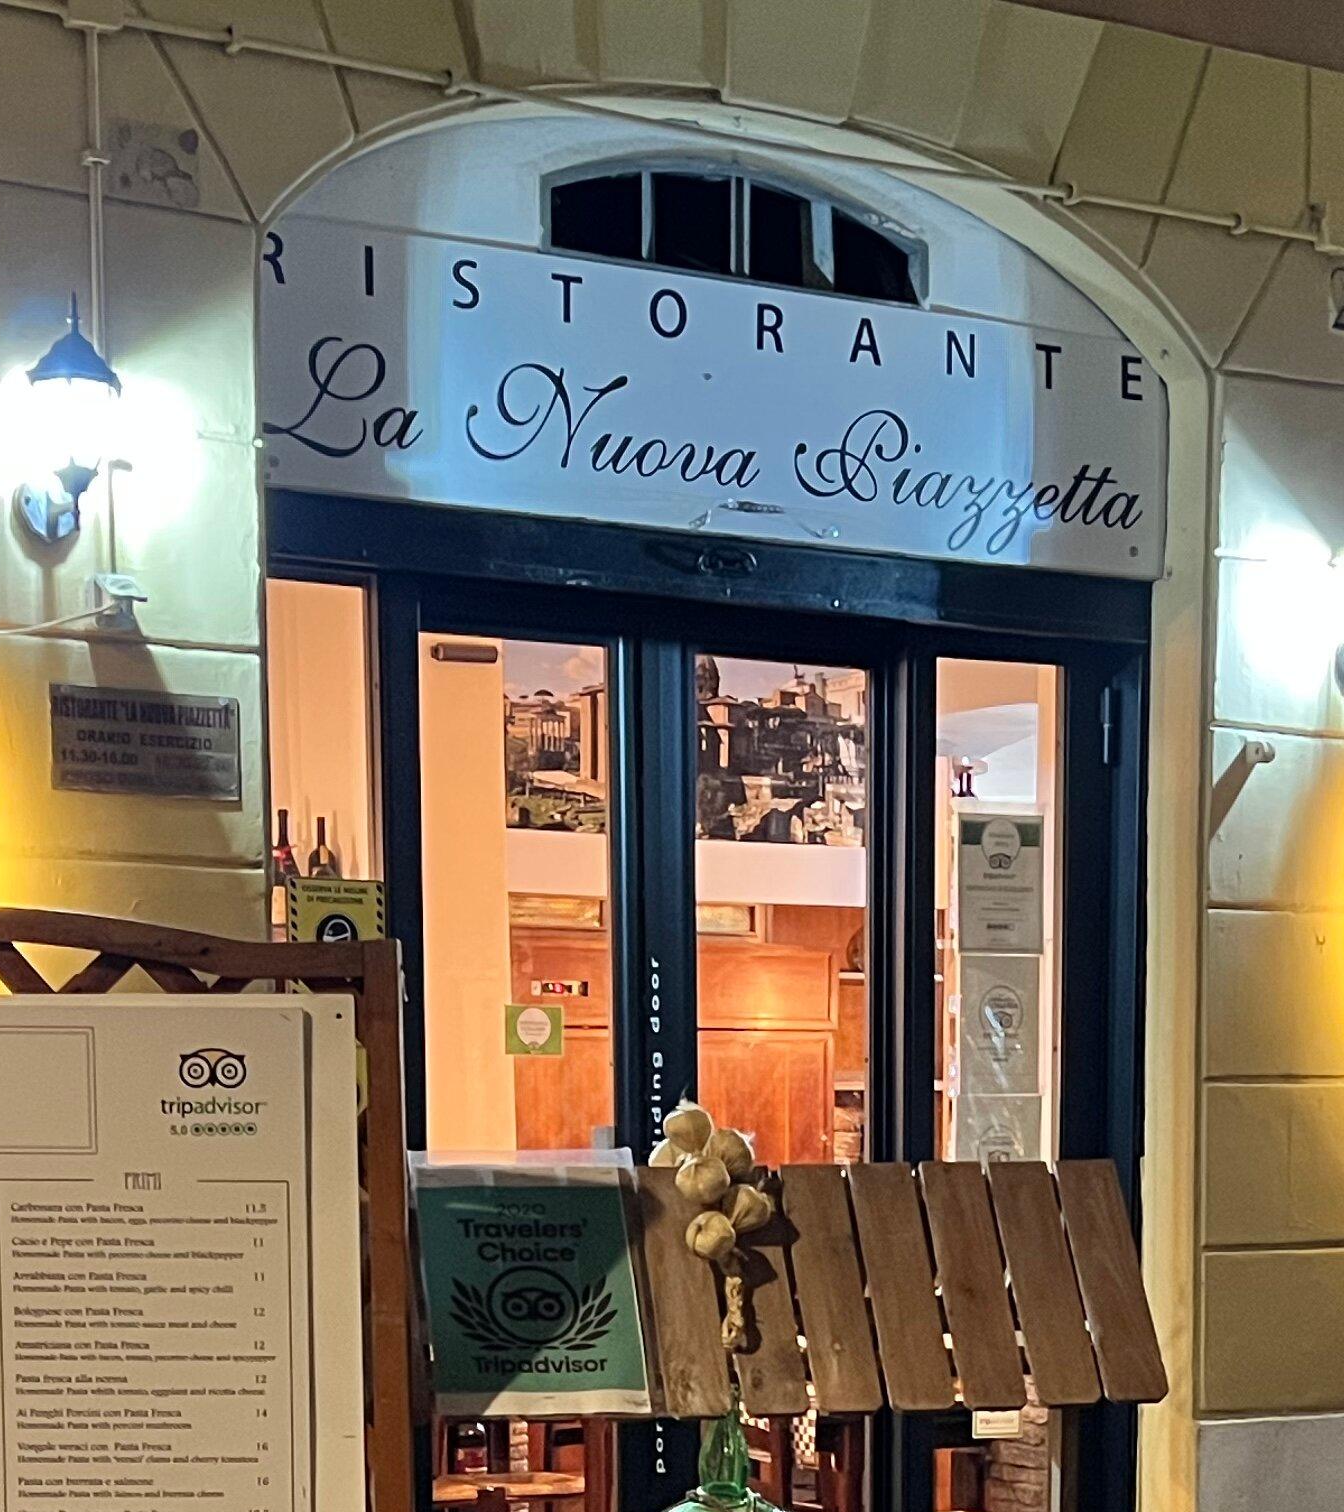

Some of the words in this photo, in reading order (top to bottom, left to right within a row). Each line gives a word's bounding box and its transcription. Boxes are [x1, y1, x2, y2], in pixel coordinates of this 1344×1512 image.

[262, 230, 1146, 403] RISTORANTE
[262, 335, 425, 458] La
[466, 362, 761, 490] Nuova
[794, 409, 1145, 554] Piazzetta
[76, 728, 131, 747] ORARIO
[140, 733, 213, 750] ESERCIZIO
[649, 956, 661, 1033] door
[160, 1097, 262, 1117] tripadvisor
[650, 1052, 664, 1147] liding
[124, 1172, 162, 1190] PRIMI
[495, 1202, 546, 1218] 2020
[456, 1217, 589, 1239] Travelers'
[477, 1242, 576, 1263] Choice
[472, 1354, 608, 1375] Tripadvisor
